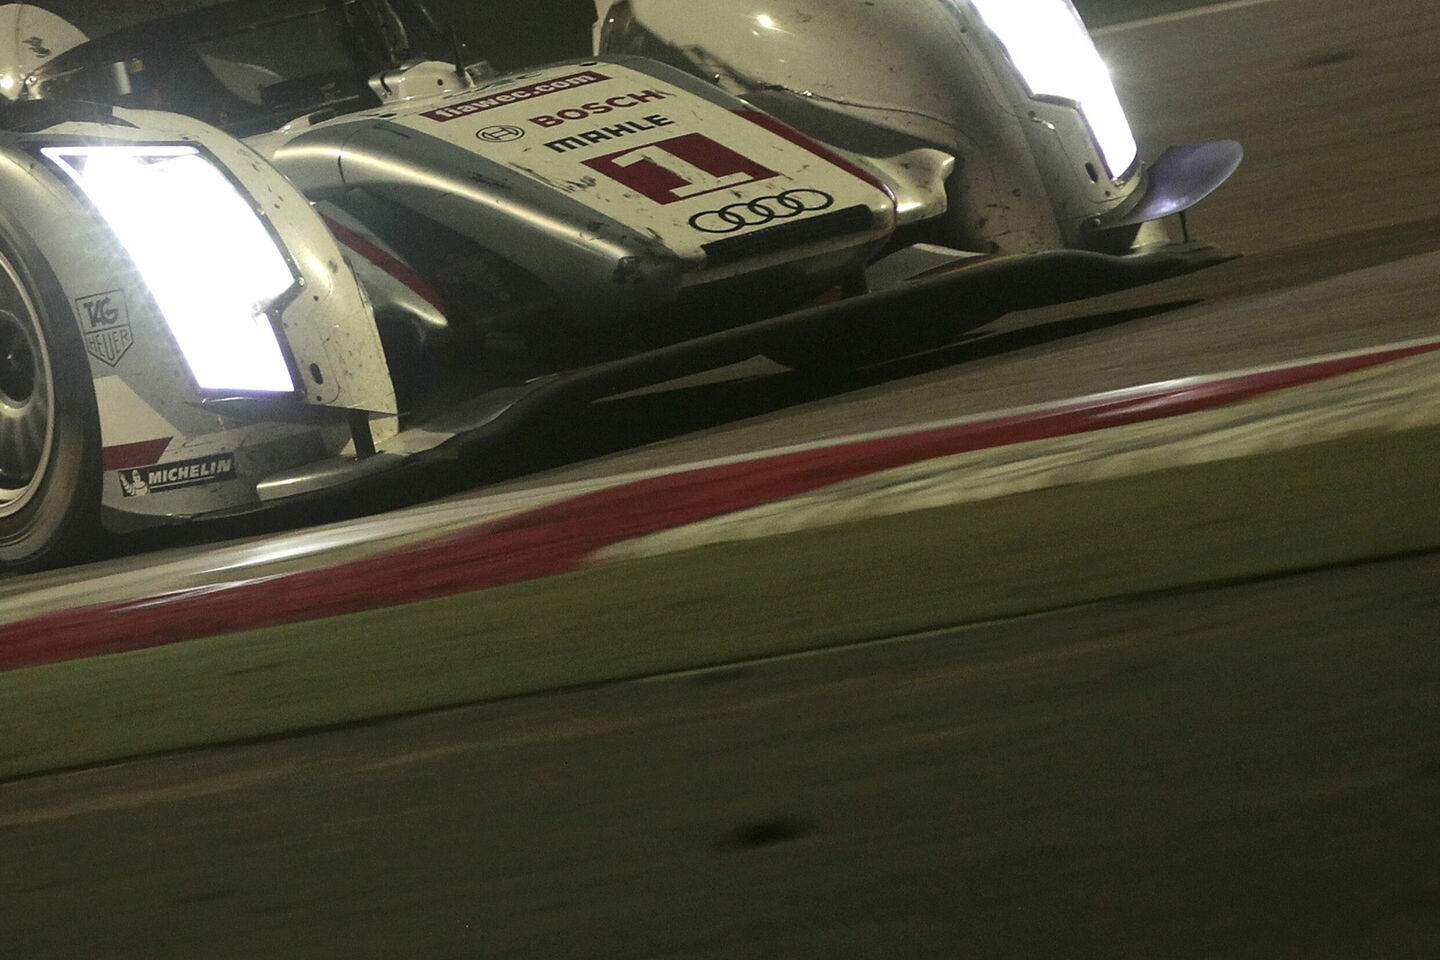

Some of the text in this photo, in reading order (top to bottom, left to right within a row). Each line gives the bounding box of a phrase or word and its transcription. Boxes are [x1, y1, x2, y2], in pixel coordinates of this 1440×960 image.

[433, 73, 599, 120] fiawec.com
[528, 89, 667, 129] BOSCH
[543, 113, 676, 153] MAHLE
[611, 144, 755, 198] 1
[83, 296, 119, 328] TAG
[89, 328, 131, 361] HEUER
[147, 457, 233, 486] MICHELIN
